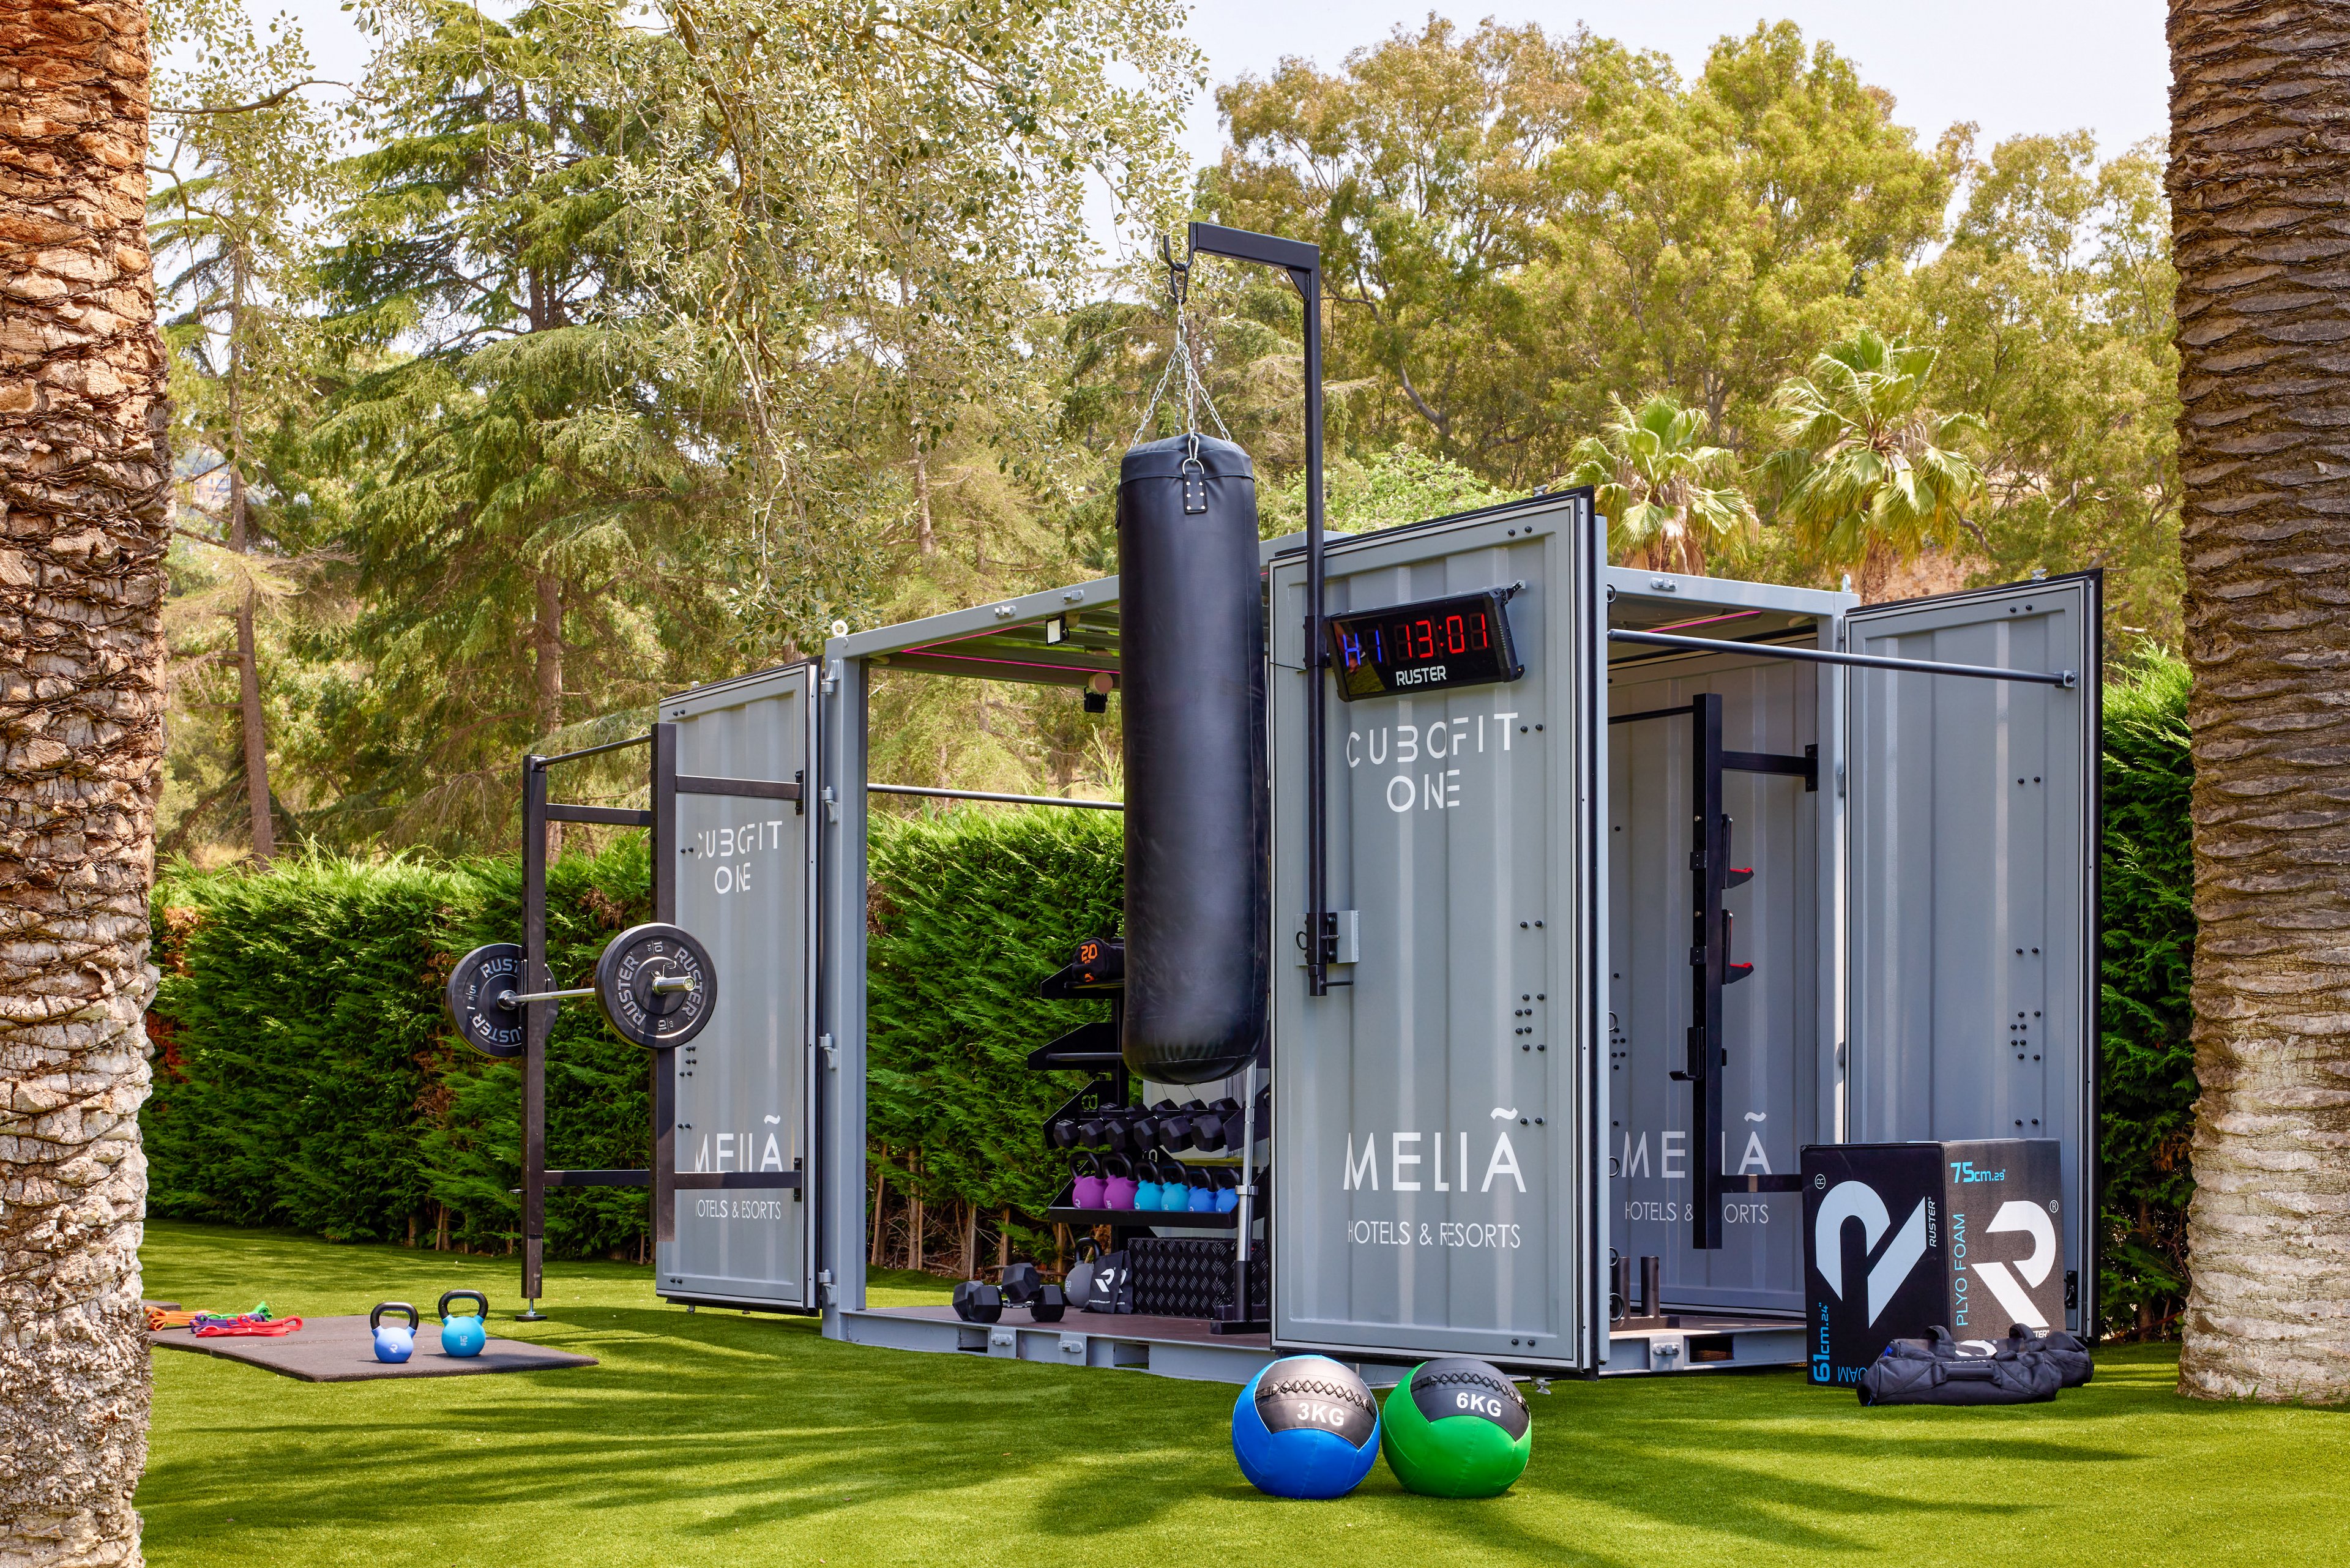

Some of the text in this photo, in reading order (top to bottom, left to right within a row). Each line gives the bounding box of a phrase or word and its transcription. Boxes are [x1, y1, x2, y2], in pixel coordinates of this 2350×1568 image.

[1405, 613, 1488, 659] 13:01
[1396, 665, 1447, 686] RUSTER
[1387, 769, 1460, 812] ONE
[715, 862, 750, 894] ONE
[1081, 944, 1098, 961] 20
[617, 956, 646, 1026] RUSTER
[472, 1013, 520, 1043] USTER
[732, 1201, 739, 1218] &
[1625, 1201, 1677, 1221] HOTELS
[1724, 1204, 1769, 1224] ORTS
[1348, 1220, 1520, 1249] HOTELS & RESORTS
[1953, 1214, 1968, 1326] PLYO FOAM
[1297, 1403, 1345, 1427] 3KG
[1456, 1392, 1502, 1417] 6KG
